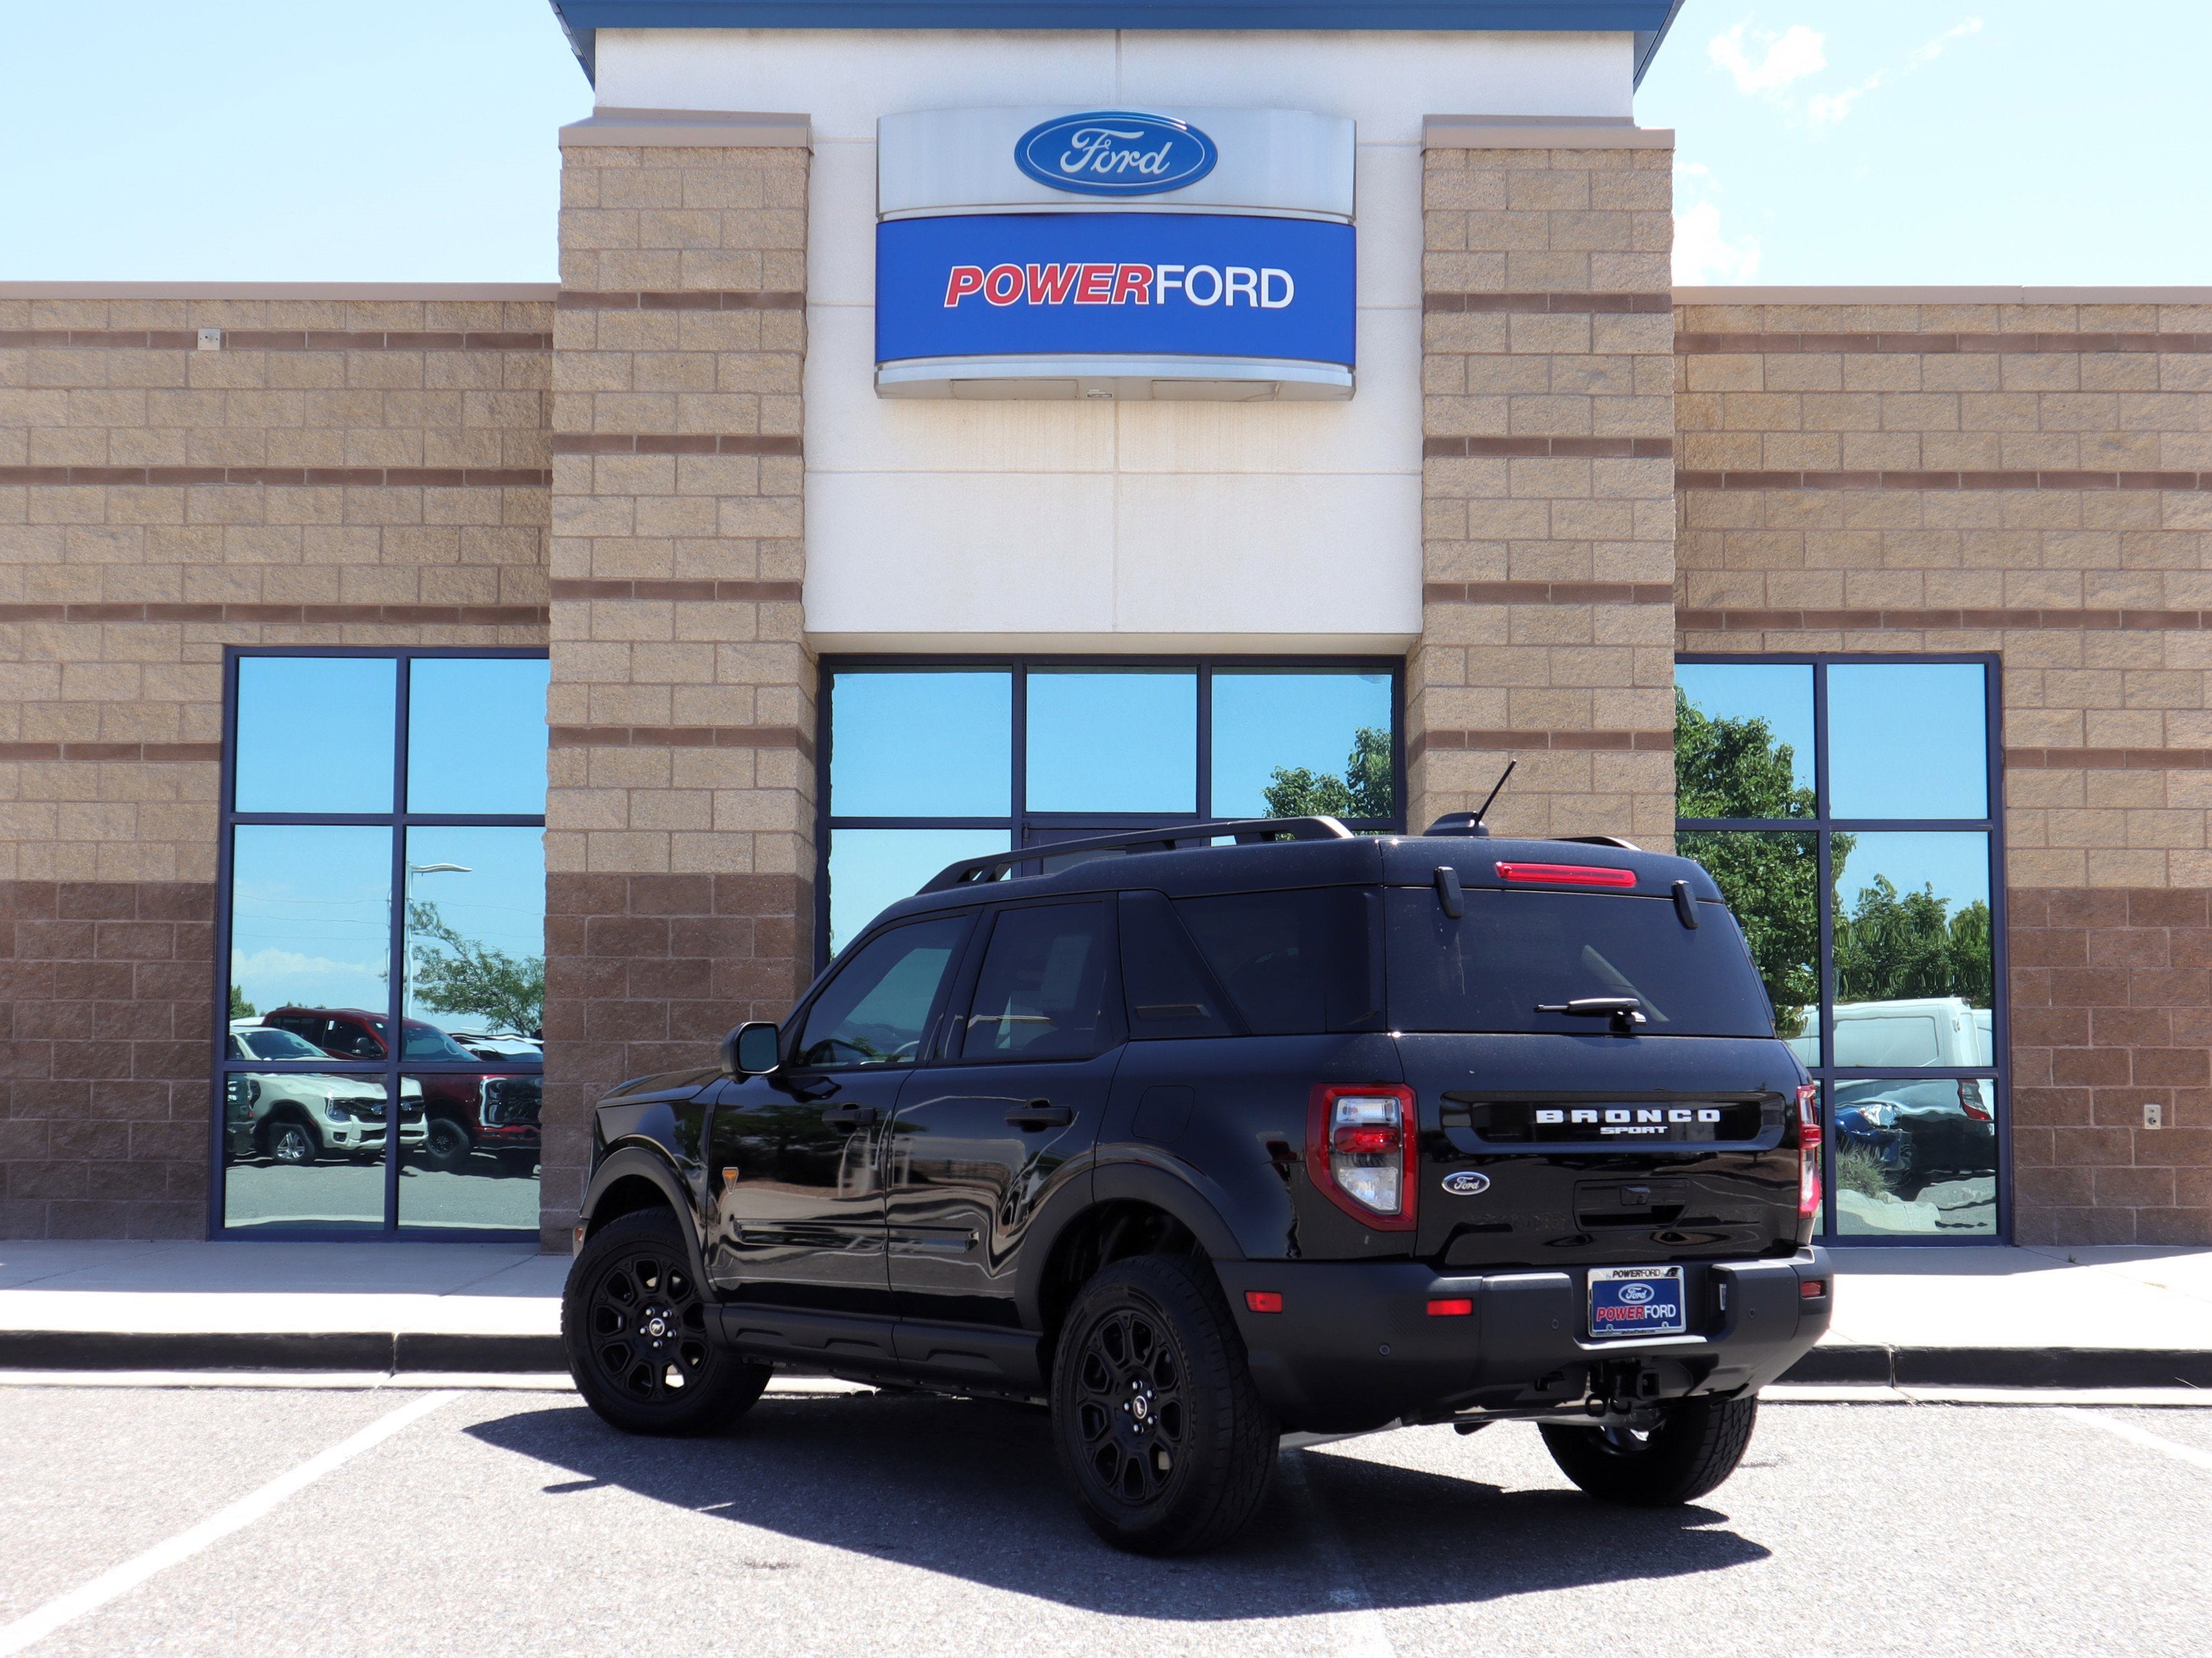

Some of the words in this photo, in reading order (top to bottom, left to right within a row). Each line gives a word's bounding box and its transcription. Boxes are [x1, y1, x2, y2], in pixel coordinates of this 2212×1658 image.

[1060, 128, 1173, 175] Ford
[943, 263, 1295, 308] POWERFORD
[1536, 1109, 1721, 1123] BRONCO
[1600, 1126, 1668, 1134] SPORT
[1454, 1176, 1480, 1190] Ford
[1612, 1269, 1661, 1279] POWERFORD
[1625, 1287, 1647, 1299] Ford
[1596, 1304, 1676, 1321] POWERFORD
